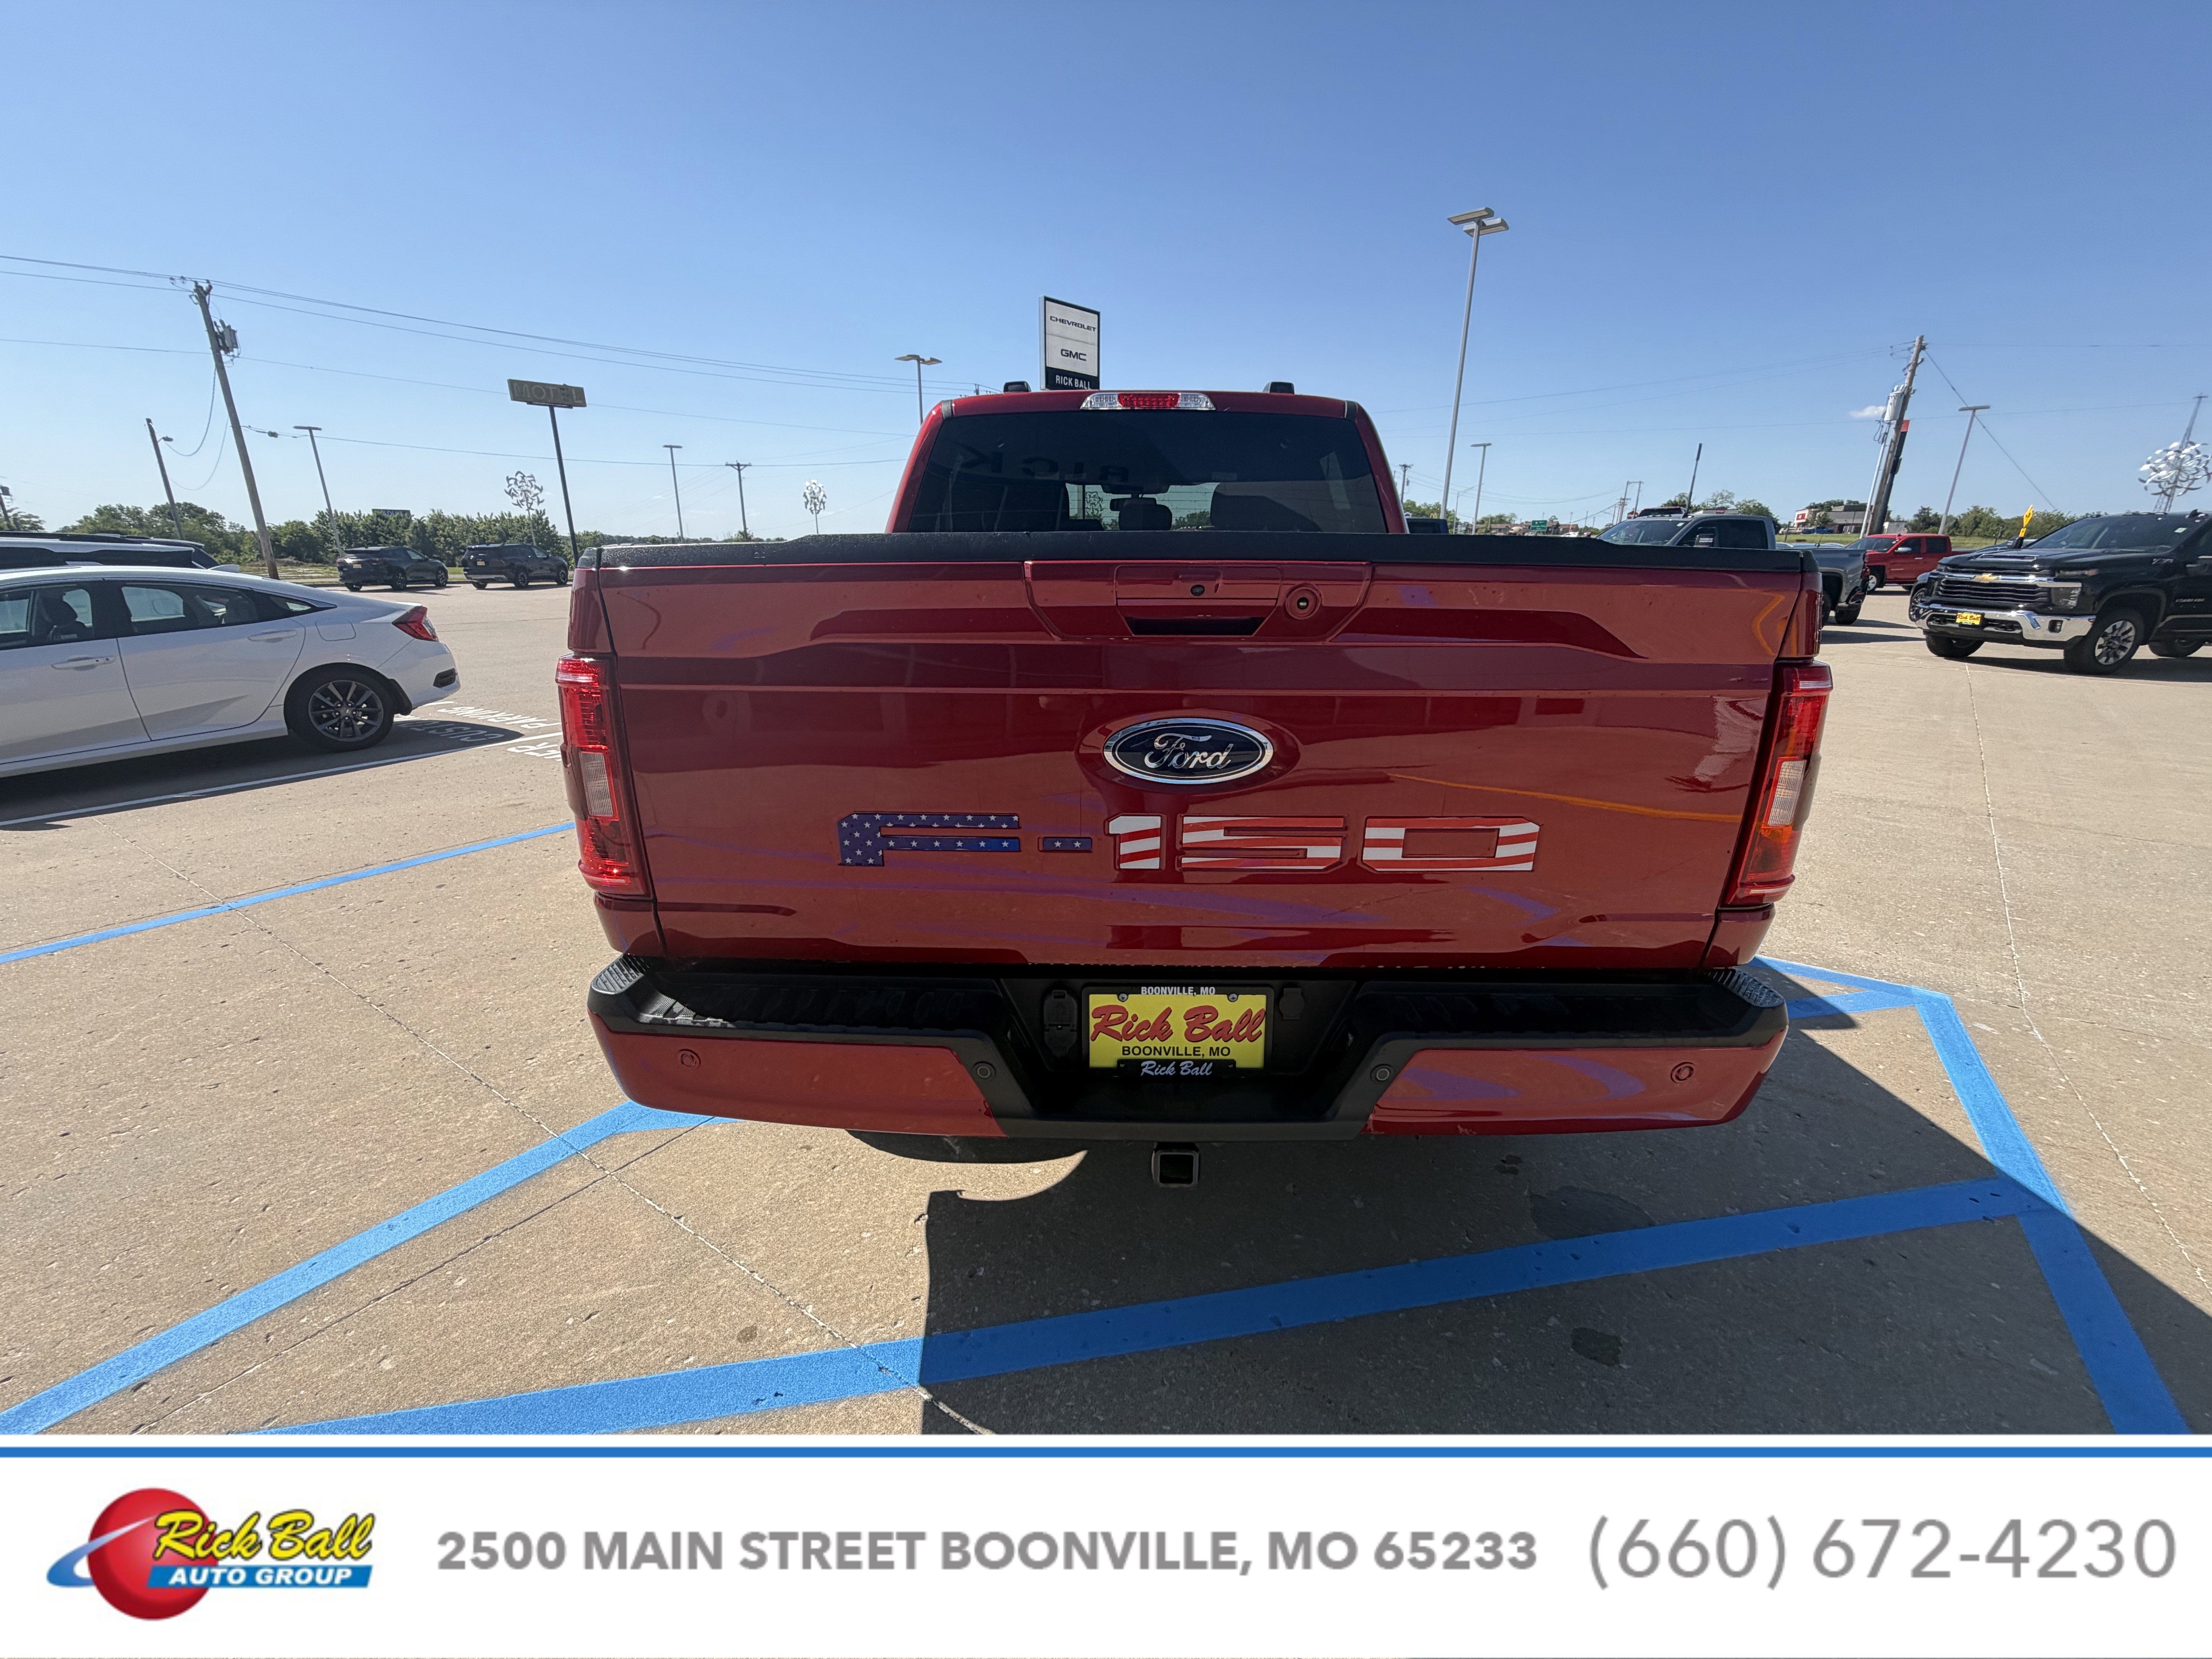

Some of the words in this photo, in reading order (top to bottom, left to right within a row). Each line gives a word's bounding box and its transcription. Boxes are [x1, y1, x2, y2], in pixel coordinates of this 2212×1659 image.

[1050, 316, 1096, 332] CHEVROLET
[1061, 349, 1087, 361] GMC
[1056, 374, 1073, 386] RICK
[1075, 378, 1091, 390] BALL
[437, 706, 561, 729] PARKING
[1144, 733, 1233, 769] Ford
[837, 813, 1540, 872] F-150
[1141, 986, 1197, 996] BOONVILLE,
[1200, 986, 1216, 995] MO
[1091, 1005, 1174, 1042] Rick
[1183, 1005, 1266, 1042] Ball
[1122, 1046, 1205, 1058] BOONVILLE,
[1209, 1046, 1231, 1056] MO
[1140, 1060, 1176, 1076] Rick
[1179, 1061, 1213, 1076] Ball
